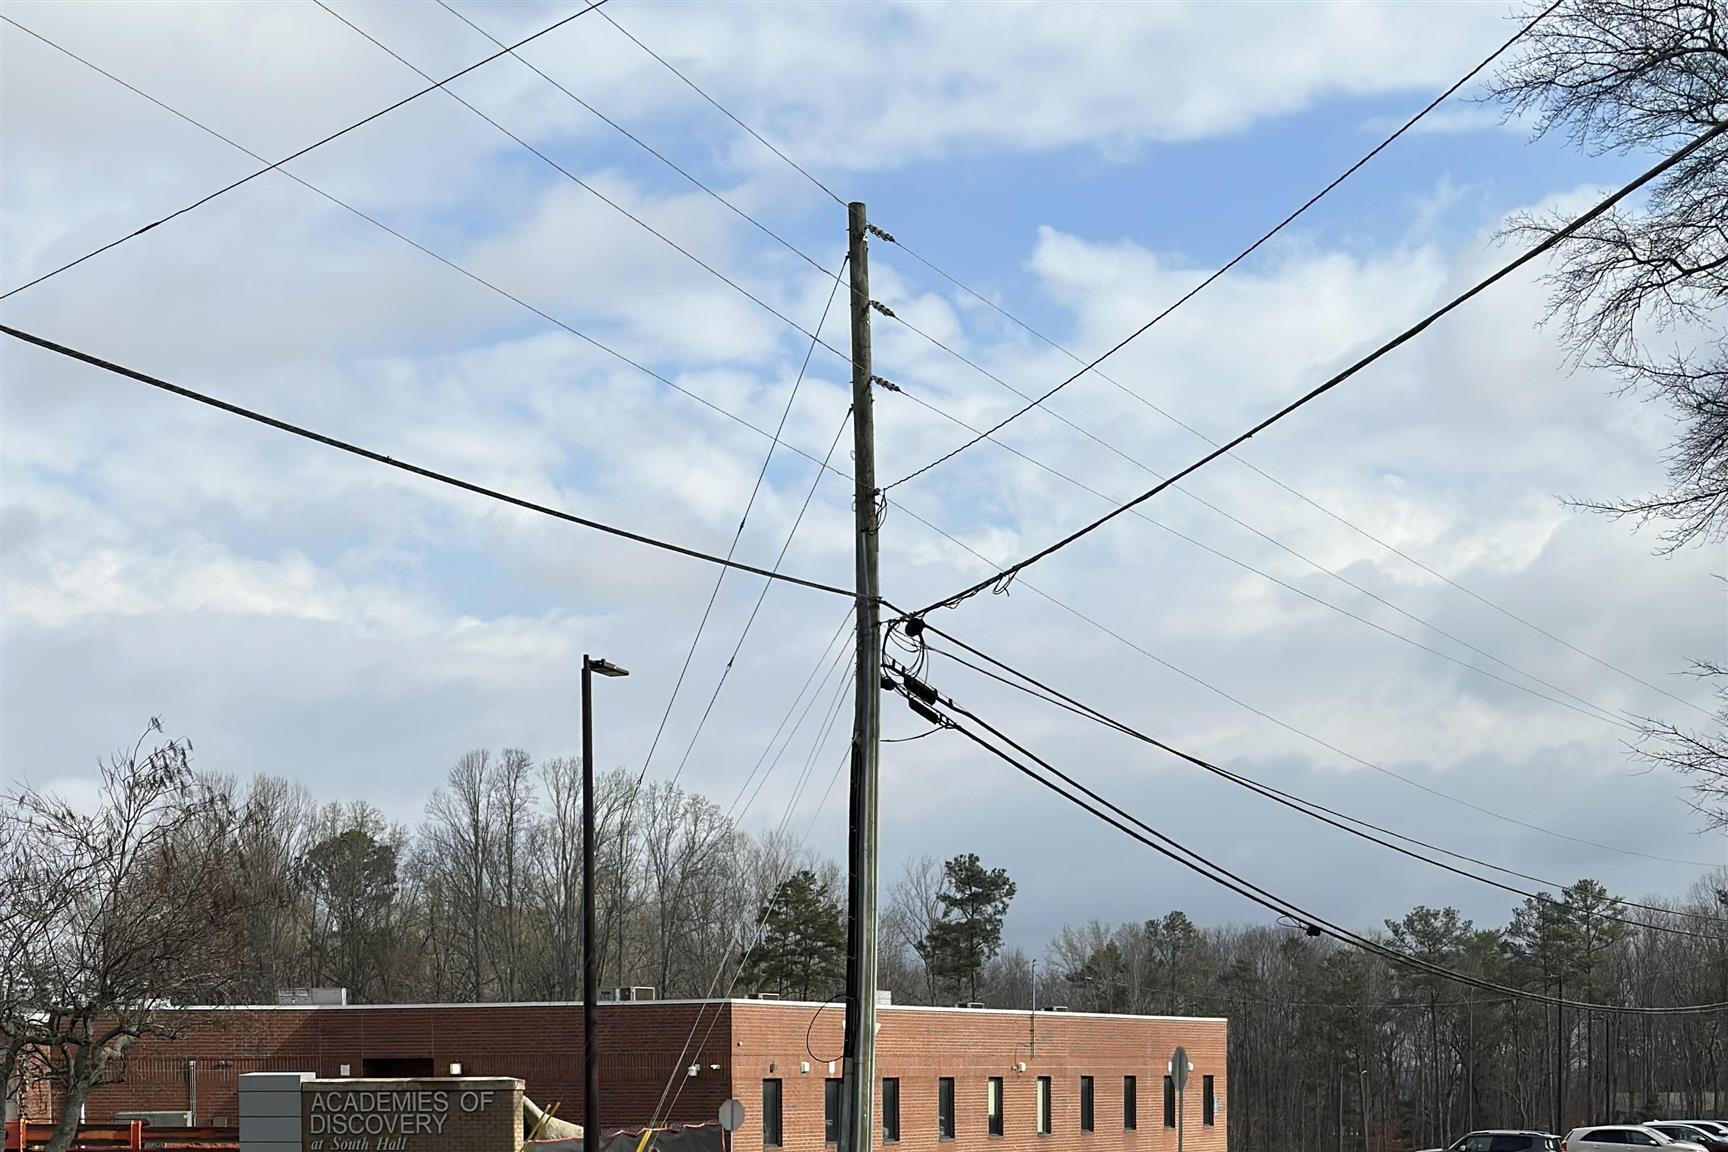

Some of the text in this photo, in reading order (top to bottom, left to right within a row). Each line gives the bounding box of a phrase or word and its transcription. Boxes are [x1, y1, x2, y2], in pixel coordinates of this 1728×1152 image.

[311, 1091, 494, 1112] ACADEMIES OF
[310, 1114, 448, 1134] DISCOVERY
[311, 1136, 407, 1151] at South Hall
